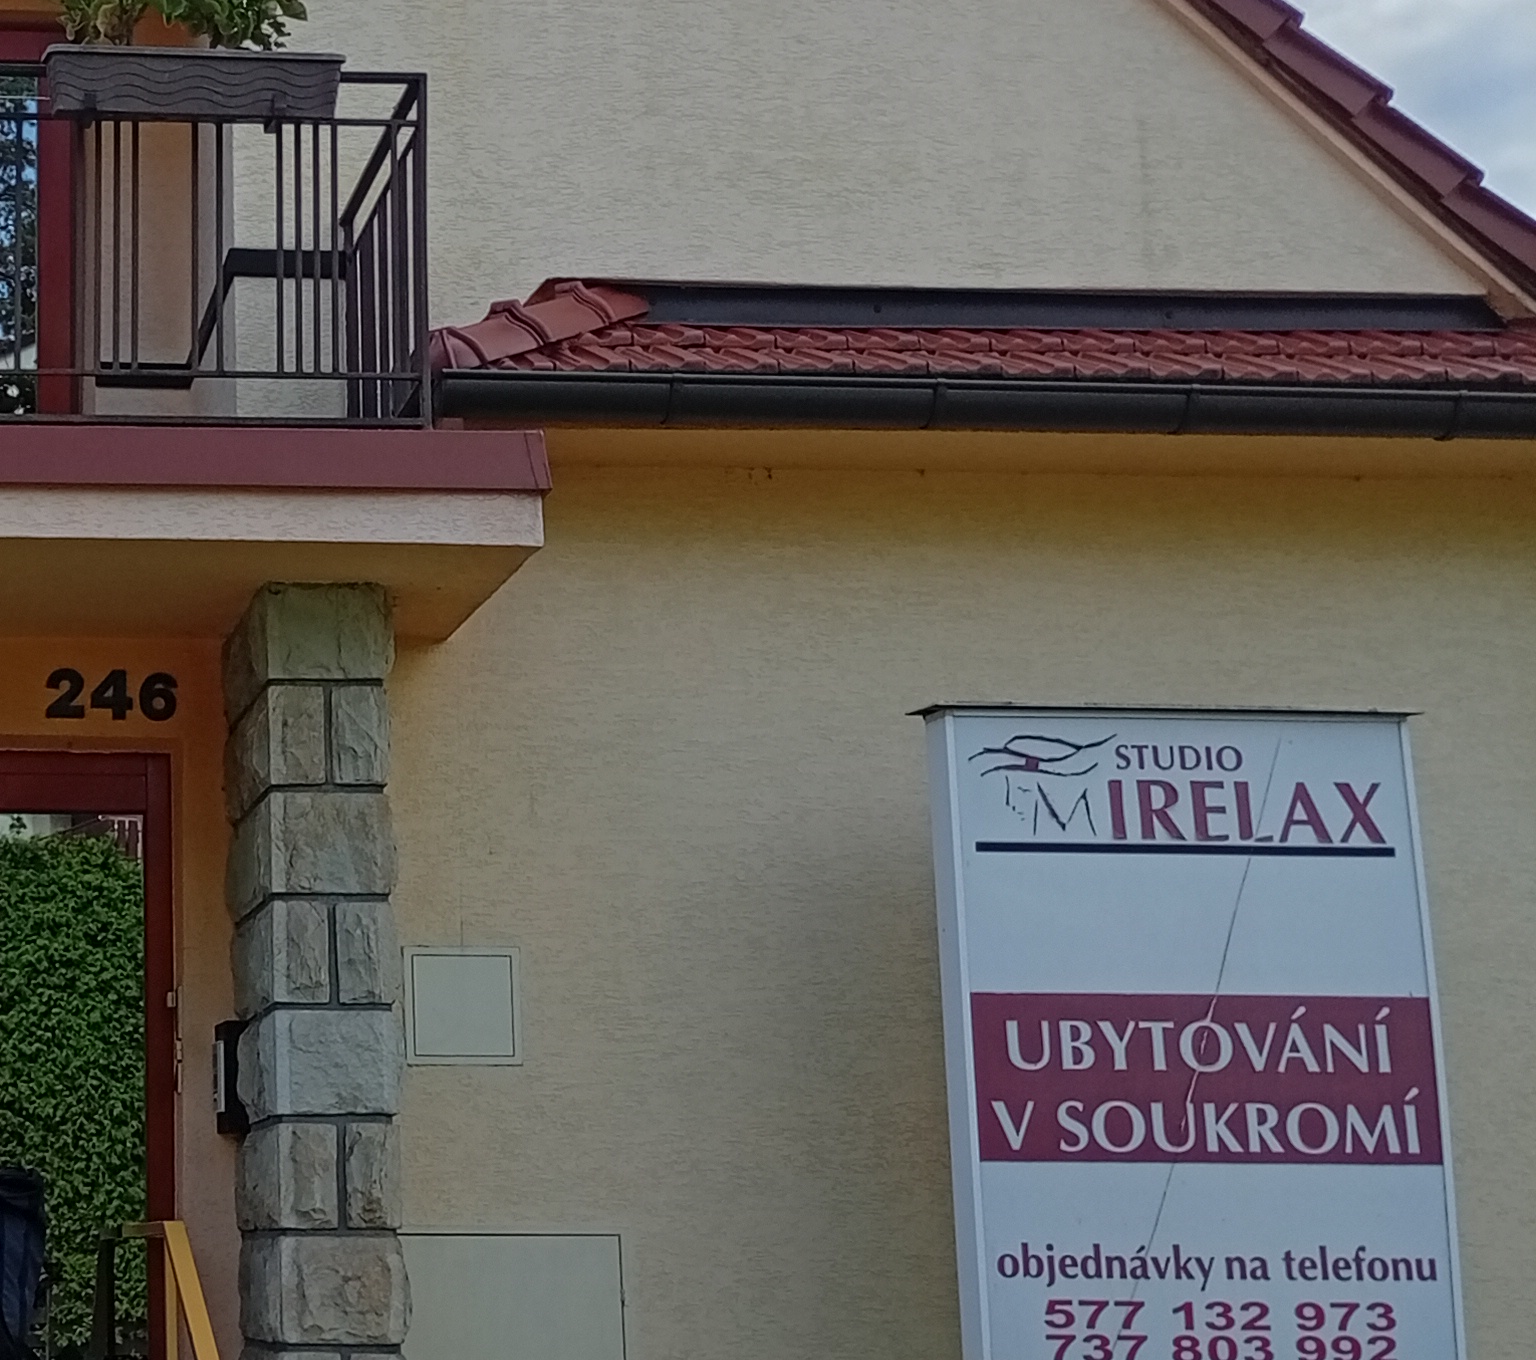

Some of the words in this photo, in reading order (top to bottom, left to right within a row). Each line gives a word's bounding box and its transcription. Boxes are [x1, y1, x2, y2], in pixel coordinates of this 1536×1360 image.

[45, 668, 178, 721] 246
[1115, 745, 1243, 771] STUDIO
[1032, 779, 1386, 844] MIRELAX
[1005, 1006, 1392, 1074] UBYTOVÁNÍ
[991, 1100, 1035, 1151] V
[1057, 1087, 1421, 1155] SOUKROMÍ
[997, 1242, 1215, 1291] objednávky
[1226, 1254, 1271, 1281] na
[1282, 1245, 1438, 1282] telefonu
[1044, 1299, 1146, 1330] 577
[1172, 1302, 1272, 1332] 132
[1294, 1302, 1397, 1333] 973
